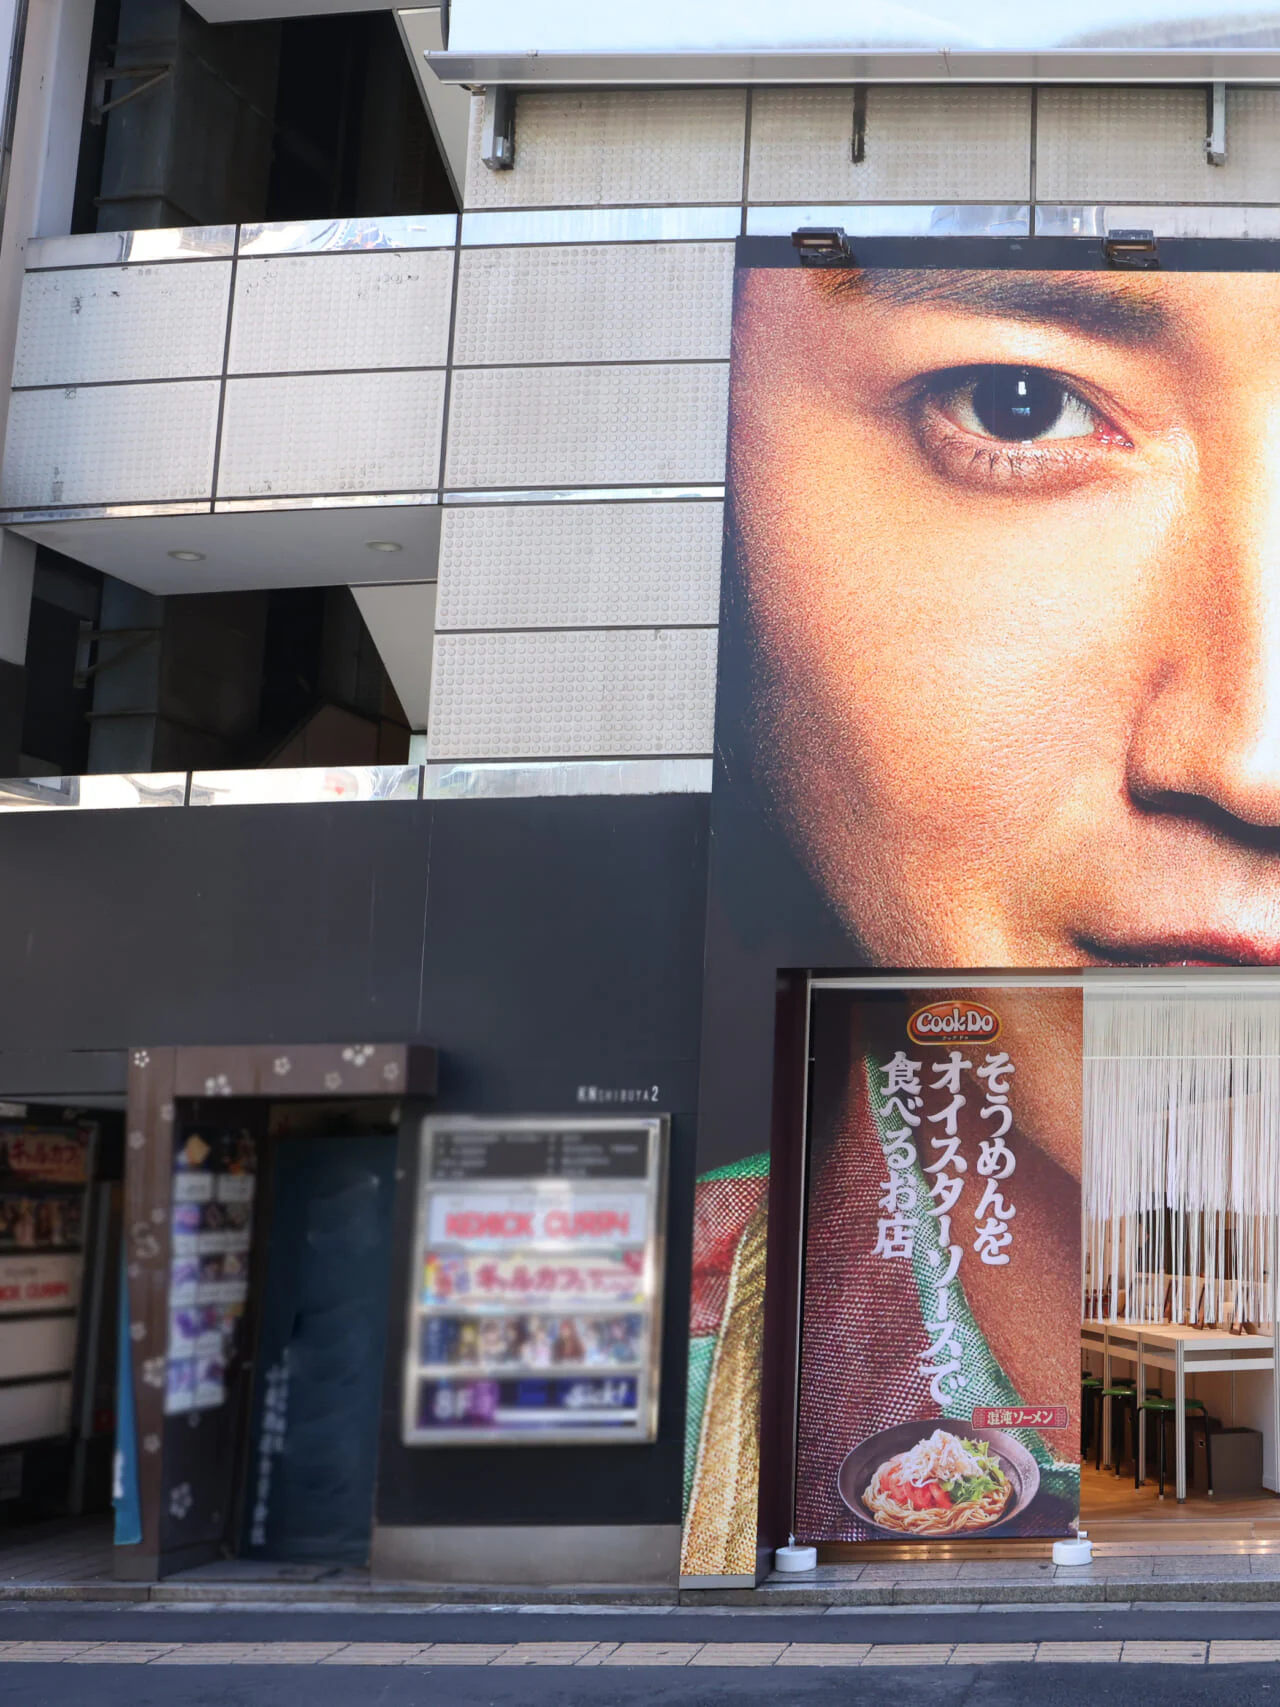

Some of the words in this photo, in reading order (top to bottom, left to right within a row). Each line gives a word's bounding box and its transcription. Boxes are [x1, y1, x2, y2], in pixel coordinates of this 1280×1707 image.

[870, 1051, 924, 1259] 食べるお店
[916, 1051, 973, 1407] オイスターソースで
[973, 1052, 1017, 1265] そうめんを
